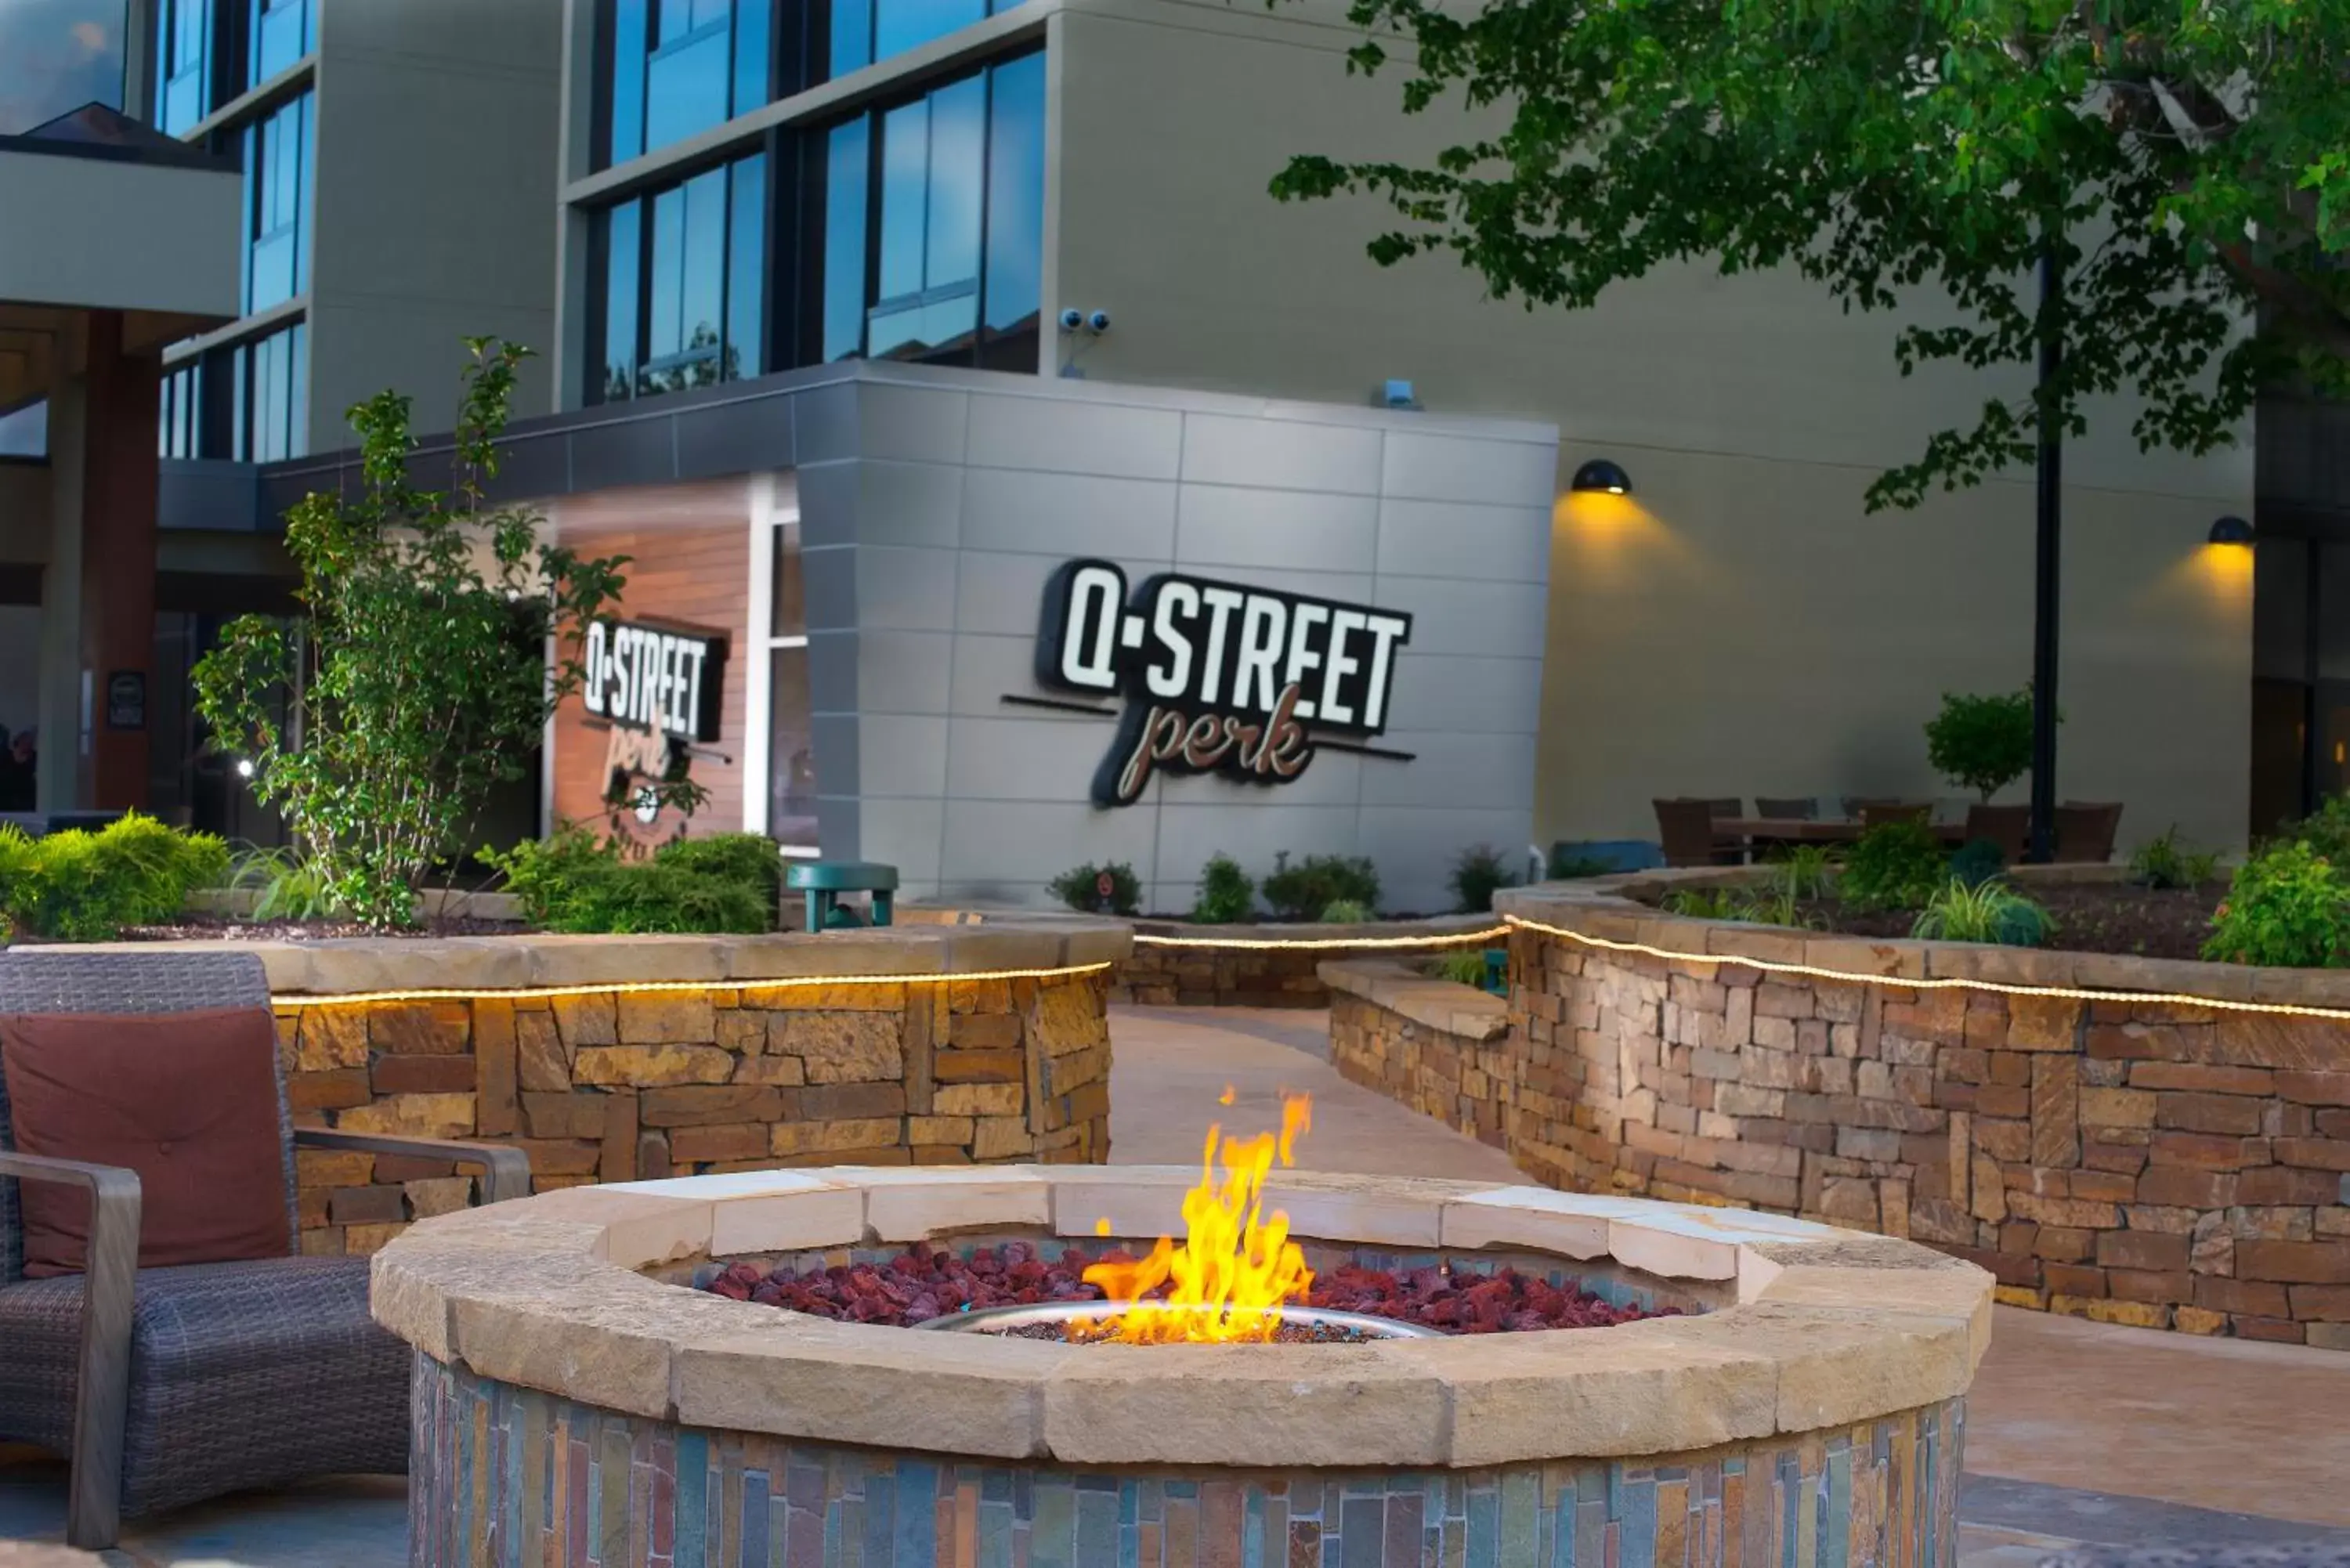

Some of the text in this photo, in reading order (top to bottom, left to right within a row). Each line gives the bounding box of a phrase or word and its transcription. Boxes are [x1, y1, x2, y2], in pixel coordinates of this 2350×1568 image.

[584, 621, 707, 735] Q-STREET
[1061, 568, 1407, 728] Q-STREET
[1118, 681, 1308, 799] perk
